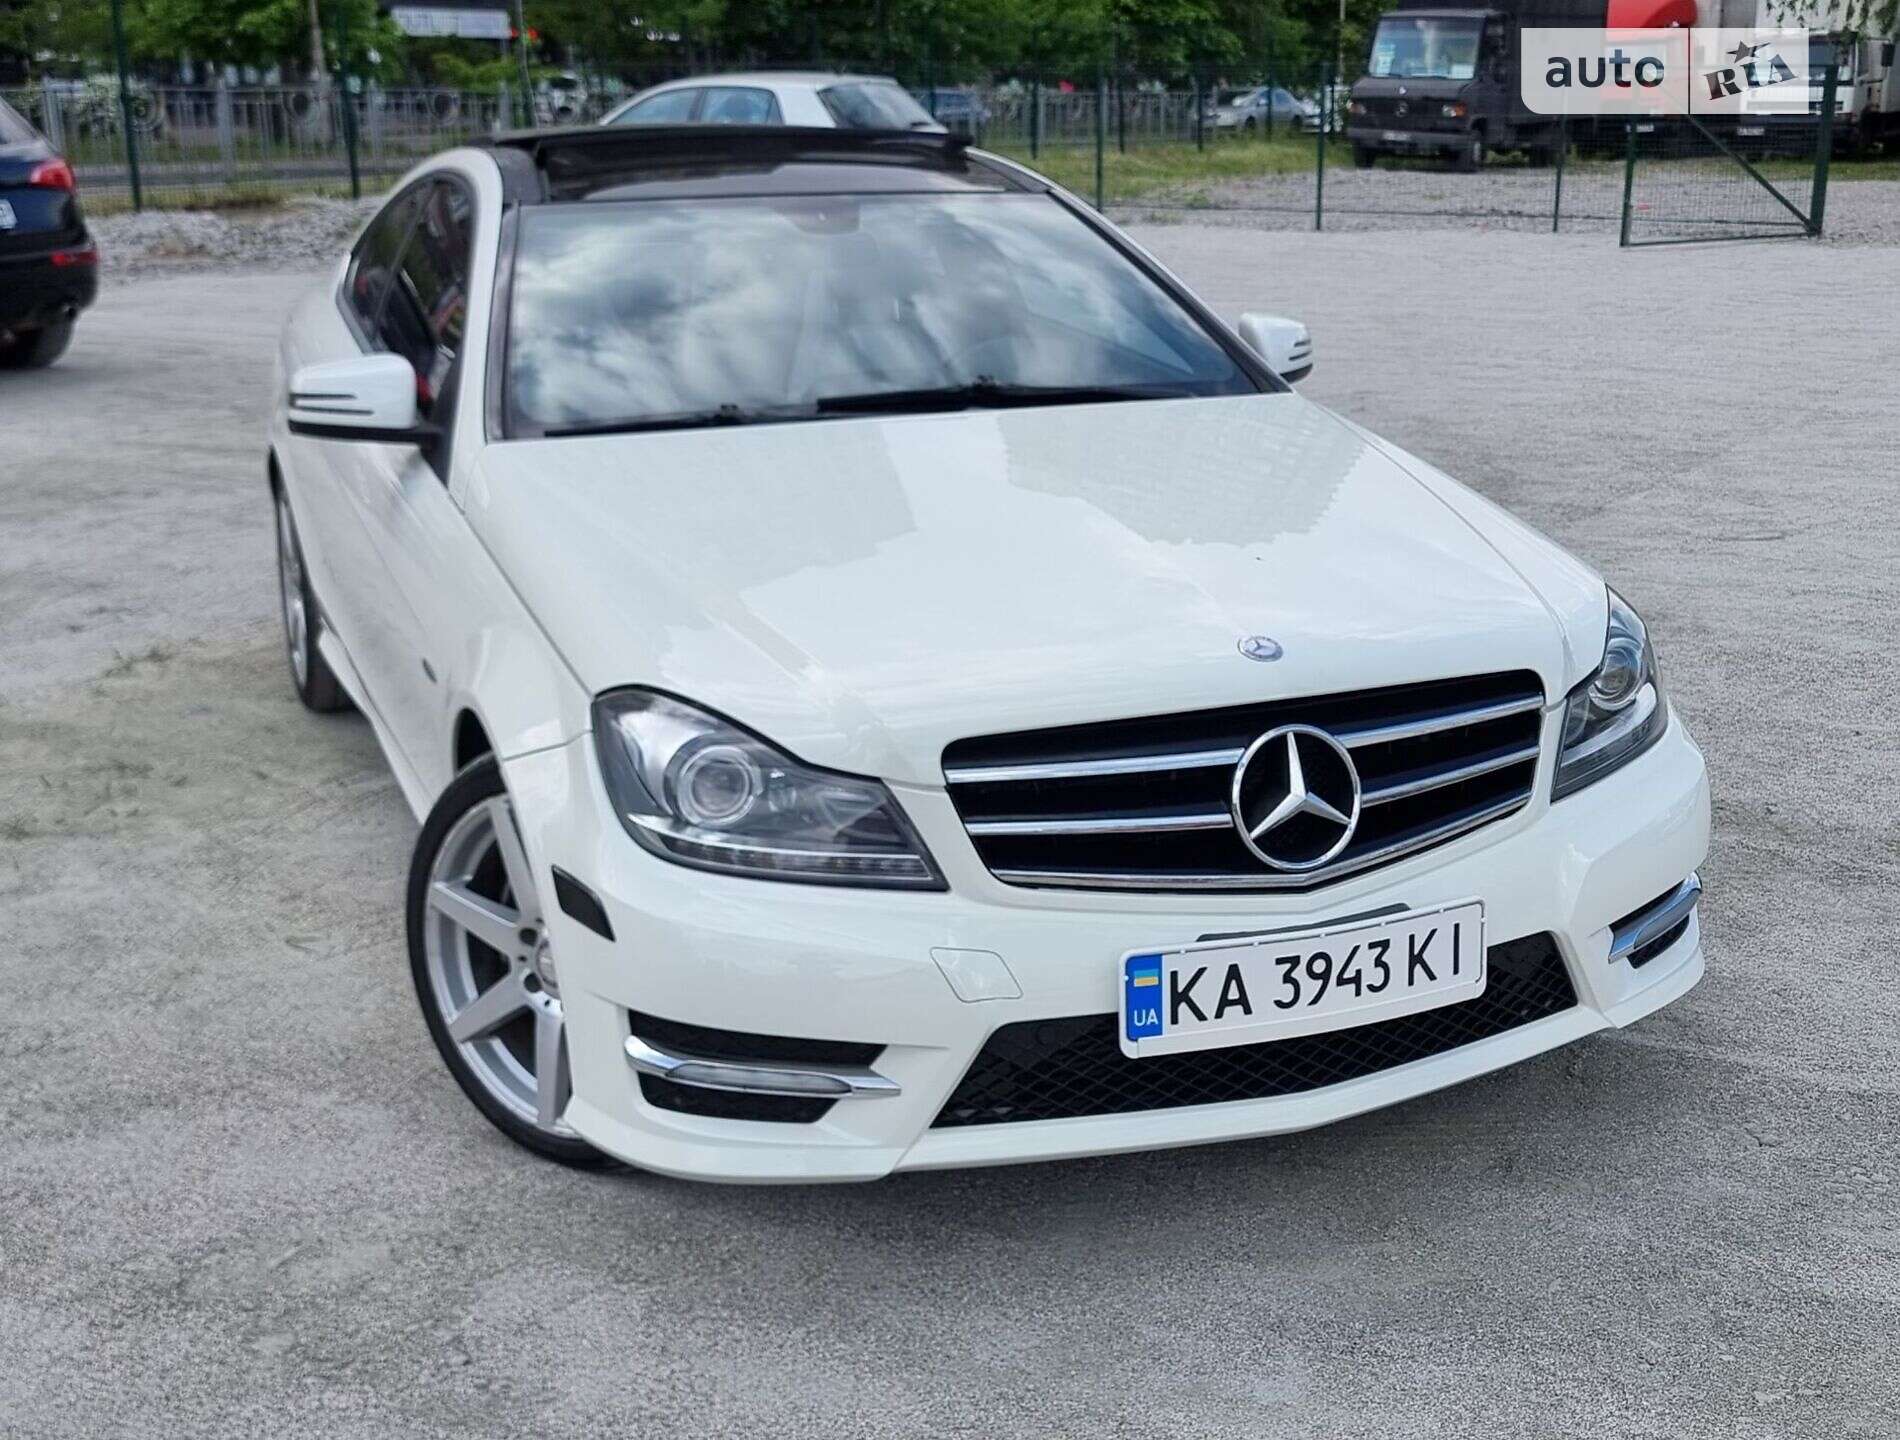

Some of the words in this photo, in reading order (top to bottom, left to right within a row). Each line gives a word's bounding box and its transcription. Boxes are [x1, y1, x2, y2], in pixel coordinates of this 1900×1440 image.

[1169, 962, 1254, 1025] KA
[1272, 938, 1391, 1009] 3943
[1133, 1008, 1159, 1027] UA
